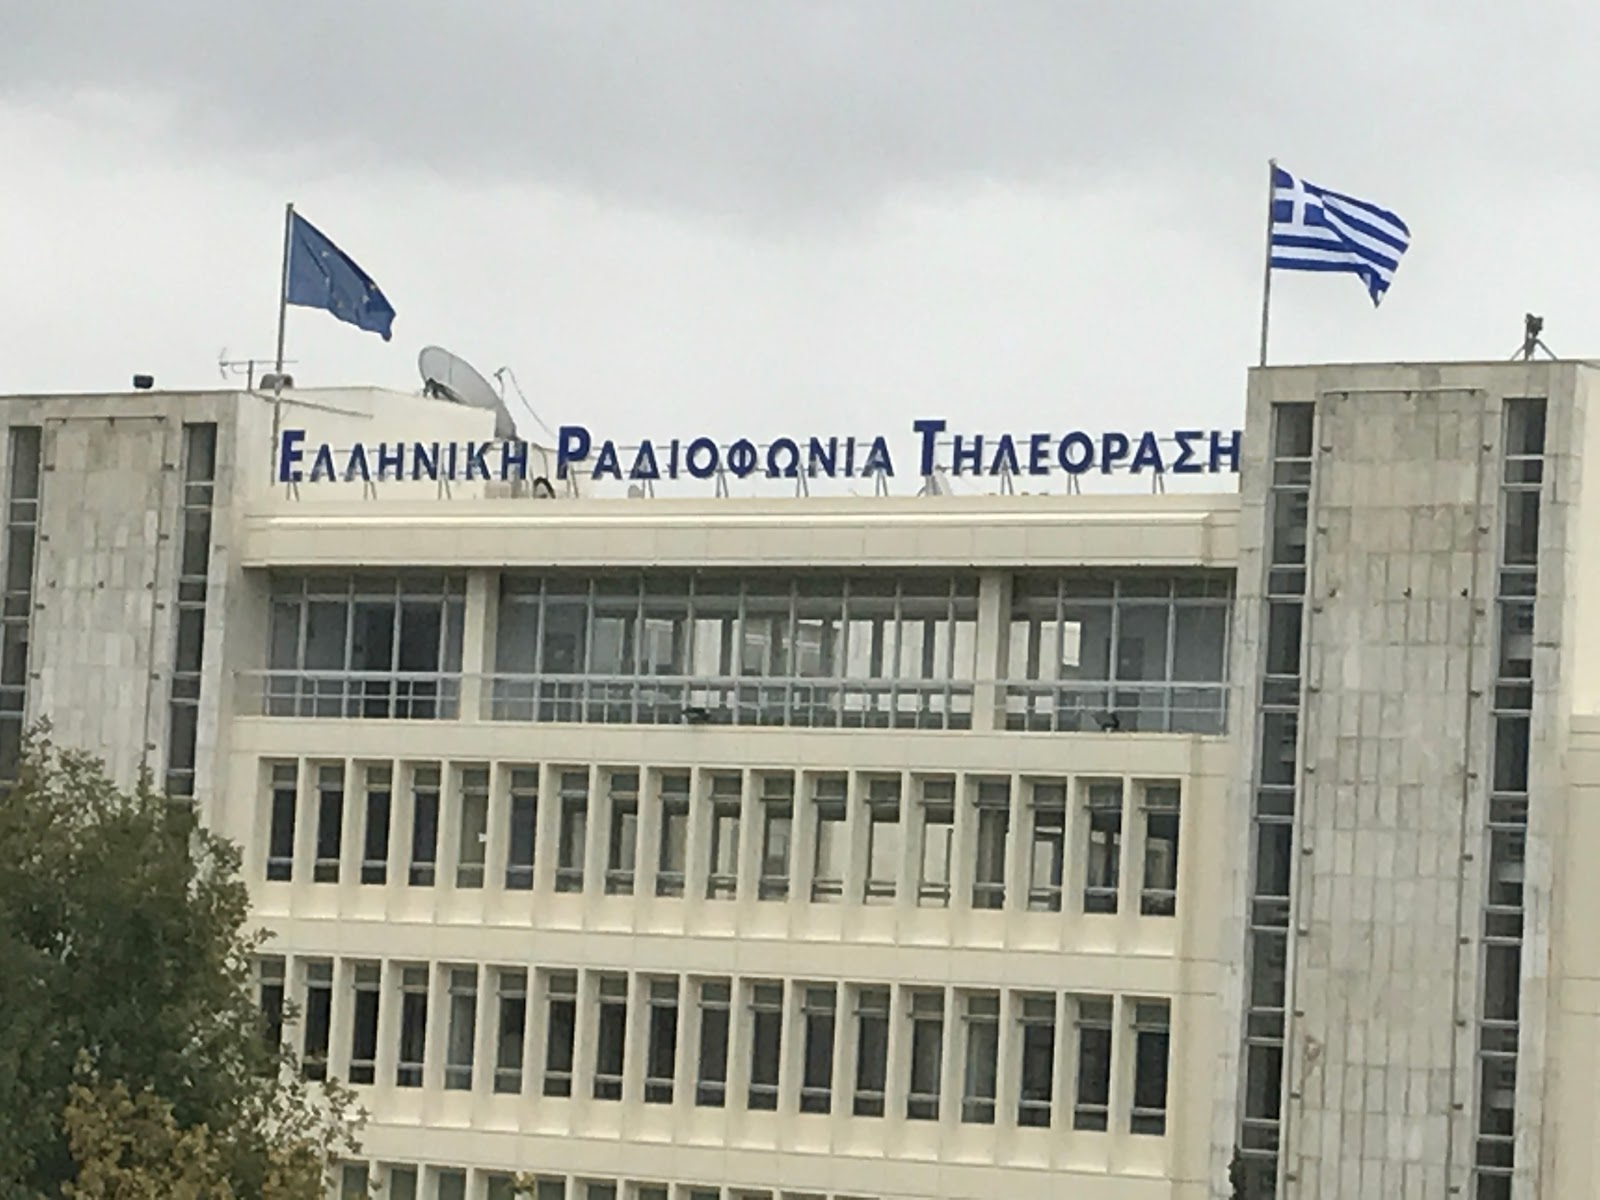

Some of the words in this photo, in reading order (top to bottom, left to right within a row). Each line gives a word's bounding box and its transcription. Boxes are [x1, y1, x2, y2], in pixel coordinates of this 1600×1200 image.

[279, 429, 529, 482] ΕΛΛΗΝΙΚΗ
[556, 426, 895, 480] ΡΑΔΙΟΦΩΝΙΑ
[913, 419, 1242, 476] ΤΗΛΕΟΡΑΣΗ
